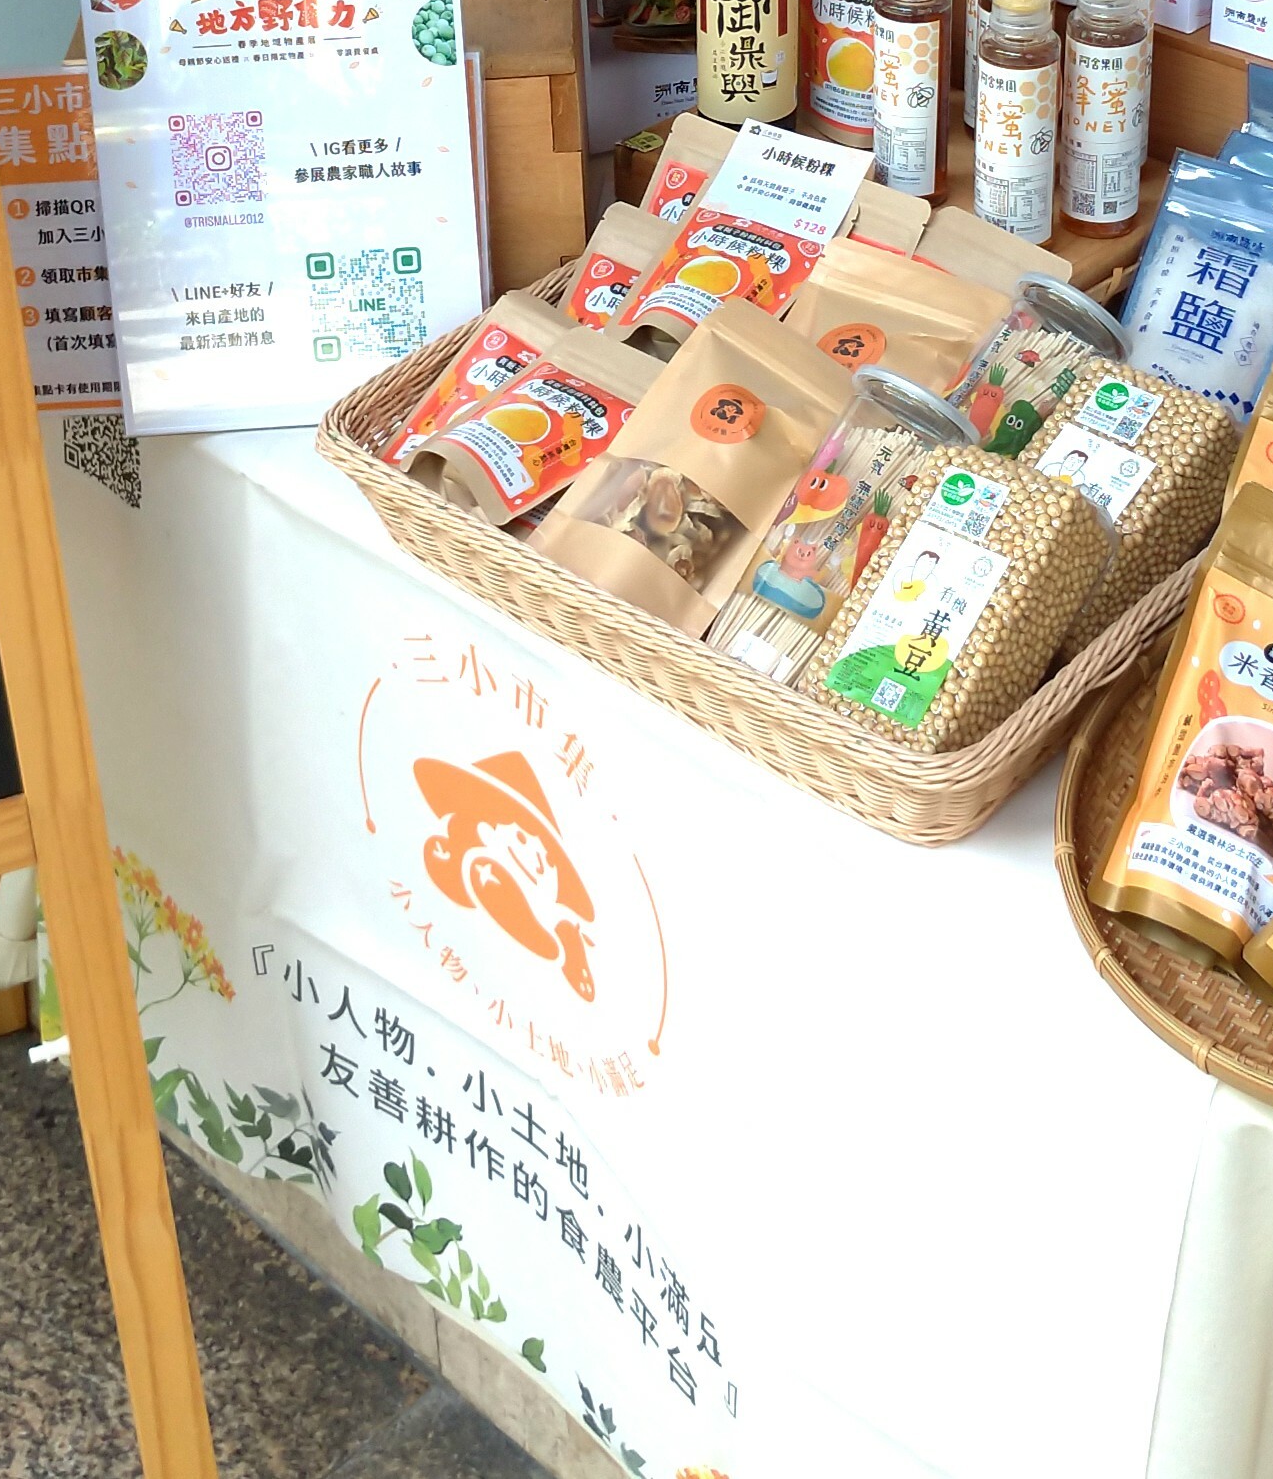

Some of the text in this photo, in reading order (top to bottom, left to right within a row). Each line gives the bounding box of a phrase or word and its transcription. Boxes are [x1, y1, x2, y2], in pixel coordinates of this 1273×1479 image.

[1078, 53, 1123, 72] 阿舍果園
[293, 160, 422, 185] 參展農家職人故事
[761, 146, 837, 178] 小時候粉粿
[35, 198, 96, 218] 掃描QR
[184, 211, 265, 230] @TRISMALL2012
[792, 218, 828, 236] $128
[691, 228, 787, 274] 小時候粉粿
[41, 266, 109, 285] 領取市集
[348, 297, 386, 314] LINE
[1162, 245, 1259, 355] 霜鹽
[185, 306, 266, 327] 來自產地的
[179, 331, 276, 353] 最新活動消息
[892, 609, 952, 682] 黃豆
[403, 633, 594, 797] 三小市集
[319, 1042, 698, 1406] 友善耕作的食農平台
